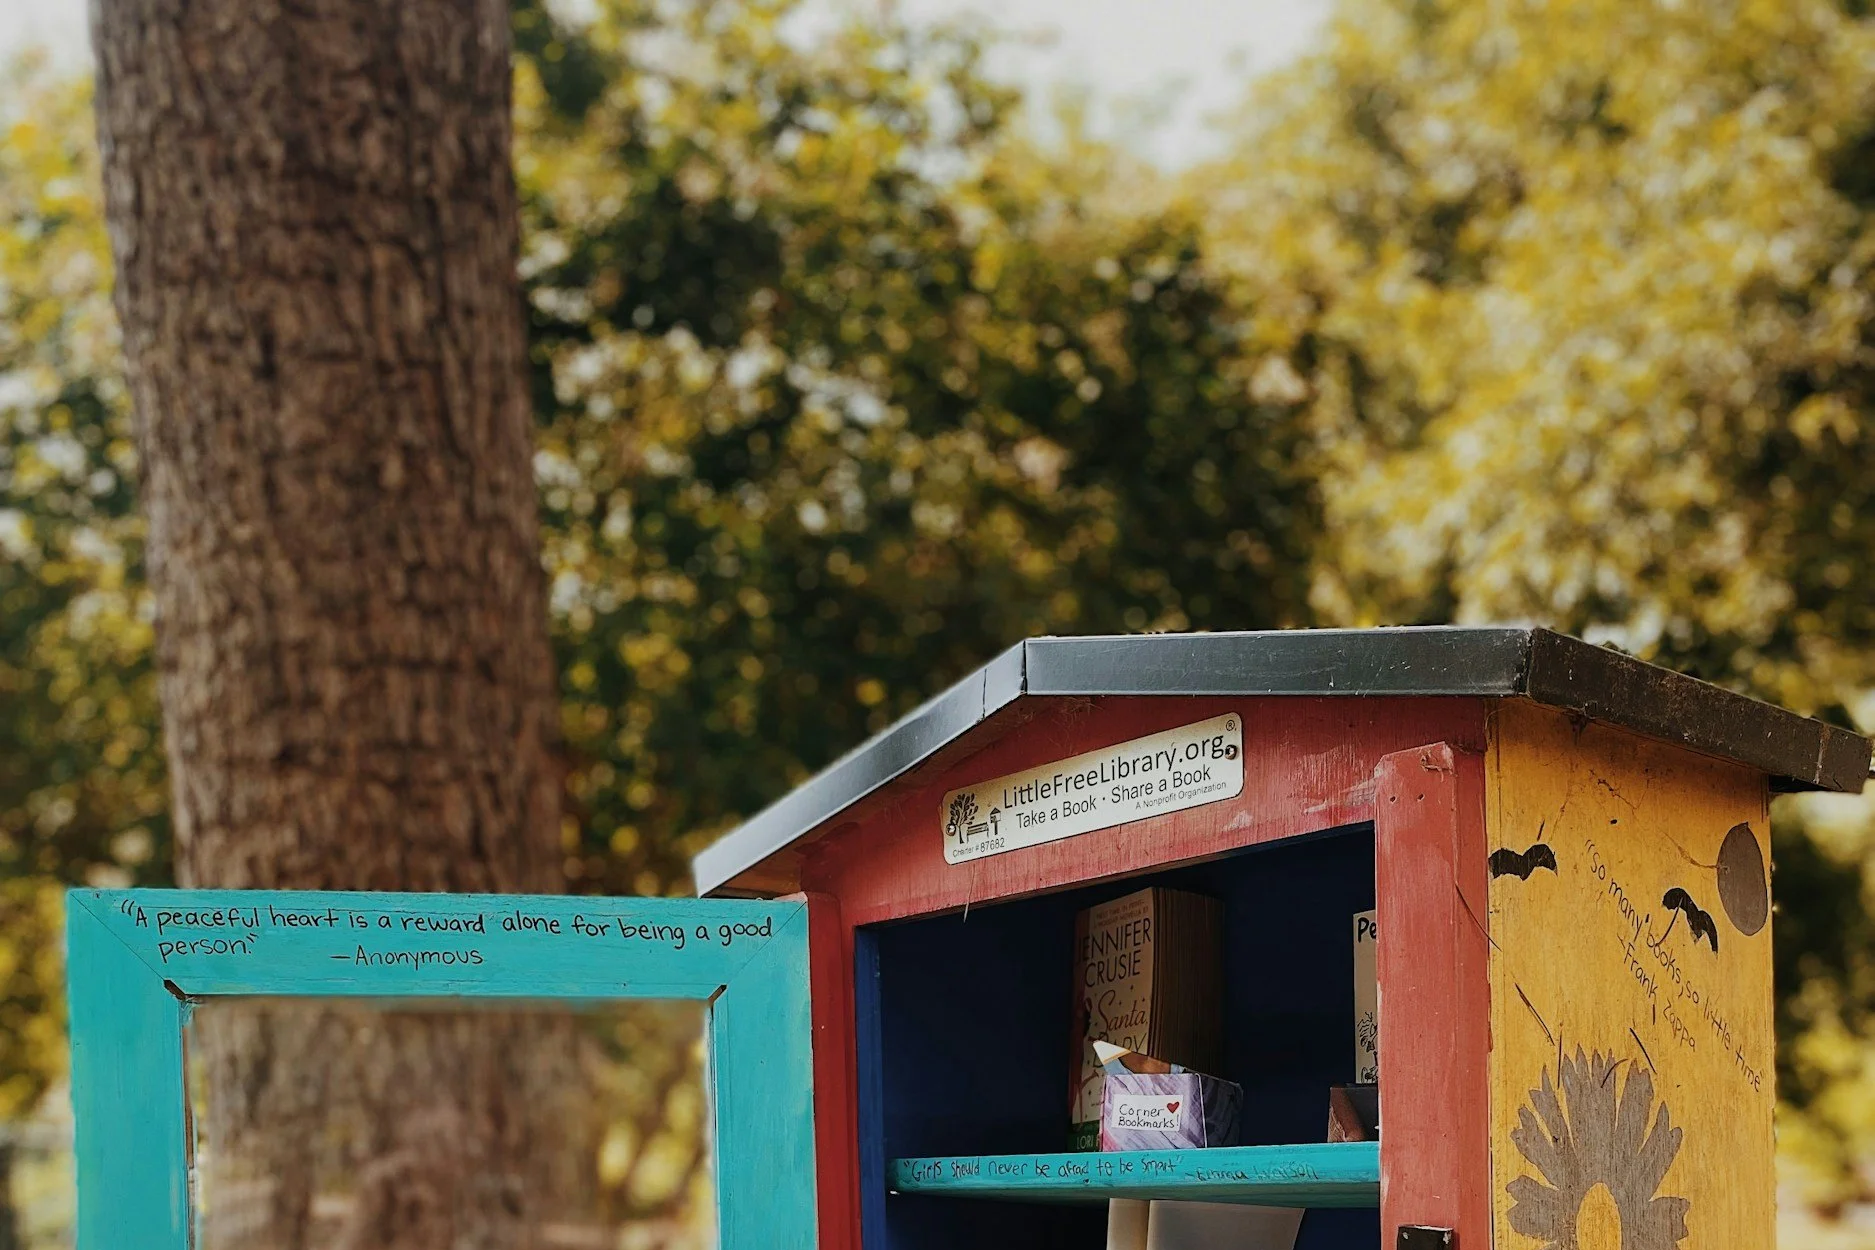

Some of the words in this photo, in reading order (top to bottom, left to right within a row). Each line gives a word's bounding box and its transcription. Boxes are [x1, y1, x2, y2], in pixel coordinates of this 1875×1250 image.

[1003, 734, 1225, 809] LittleFreeLibrary.org
[1016, 808, 1046, 829] Take
[1050, 807, 1058, 821] a
[1063, 795, 1097, 819] Book
[1111, 784, 1153, 804] Share
[1159, 777, 1167, 792] a
[1173, 764, 1211, 789] Book
[1136, 802, 1141, 810] A
[1143, 792, 1176, 808] Nonprofit
[1178, 781, 1227, 799] Organization
[980, 837, 1005, 853] 87682
[157, 907, 259, 935] peaceful
[270, 905, 339, 929] heart
[350, 910, 368, 929] is
[378, 914, 392, 929] a
[402, 912, 485, 933] reward
[503, 910, 561, 934] alone
[571, 914, 610, 938] for
[620, 917, 686, 949] being
[696, 923, 710, 940] a
[719, 915, 772, 946] good
[1076, 917, 1151, 964] JENNIFER
[1084, 950, 1142, 988] CRUSIE
[1608, 878, 1643, 942] many
[1703, 996, 1731, 1050] little
[1097, 989, 1147, 1035] Santa
[1118, 1114, 1180, 1129] Bookmarks!
[1119, 1104, 1164, 1118] Corner
[988, 1159, 1027, 1176] never
[1035, 1159, 1051, 1177] be
[1096, 1162, 1115, 1176] to
[1119, 1159, 1134, 1173] be
